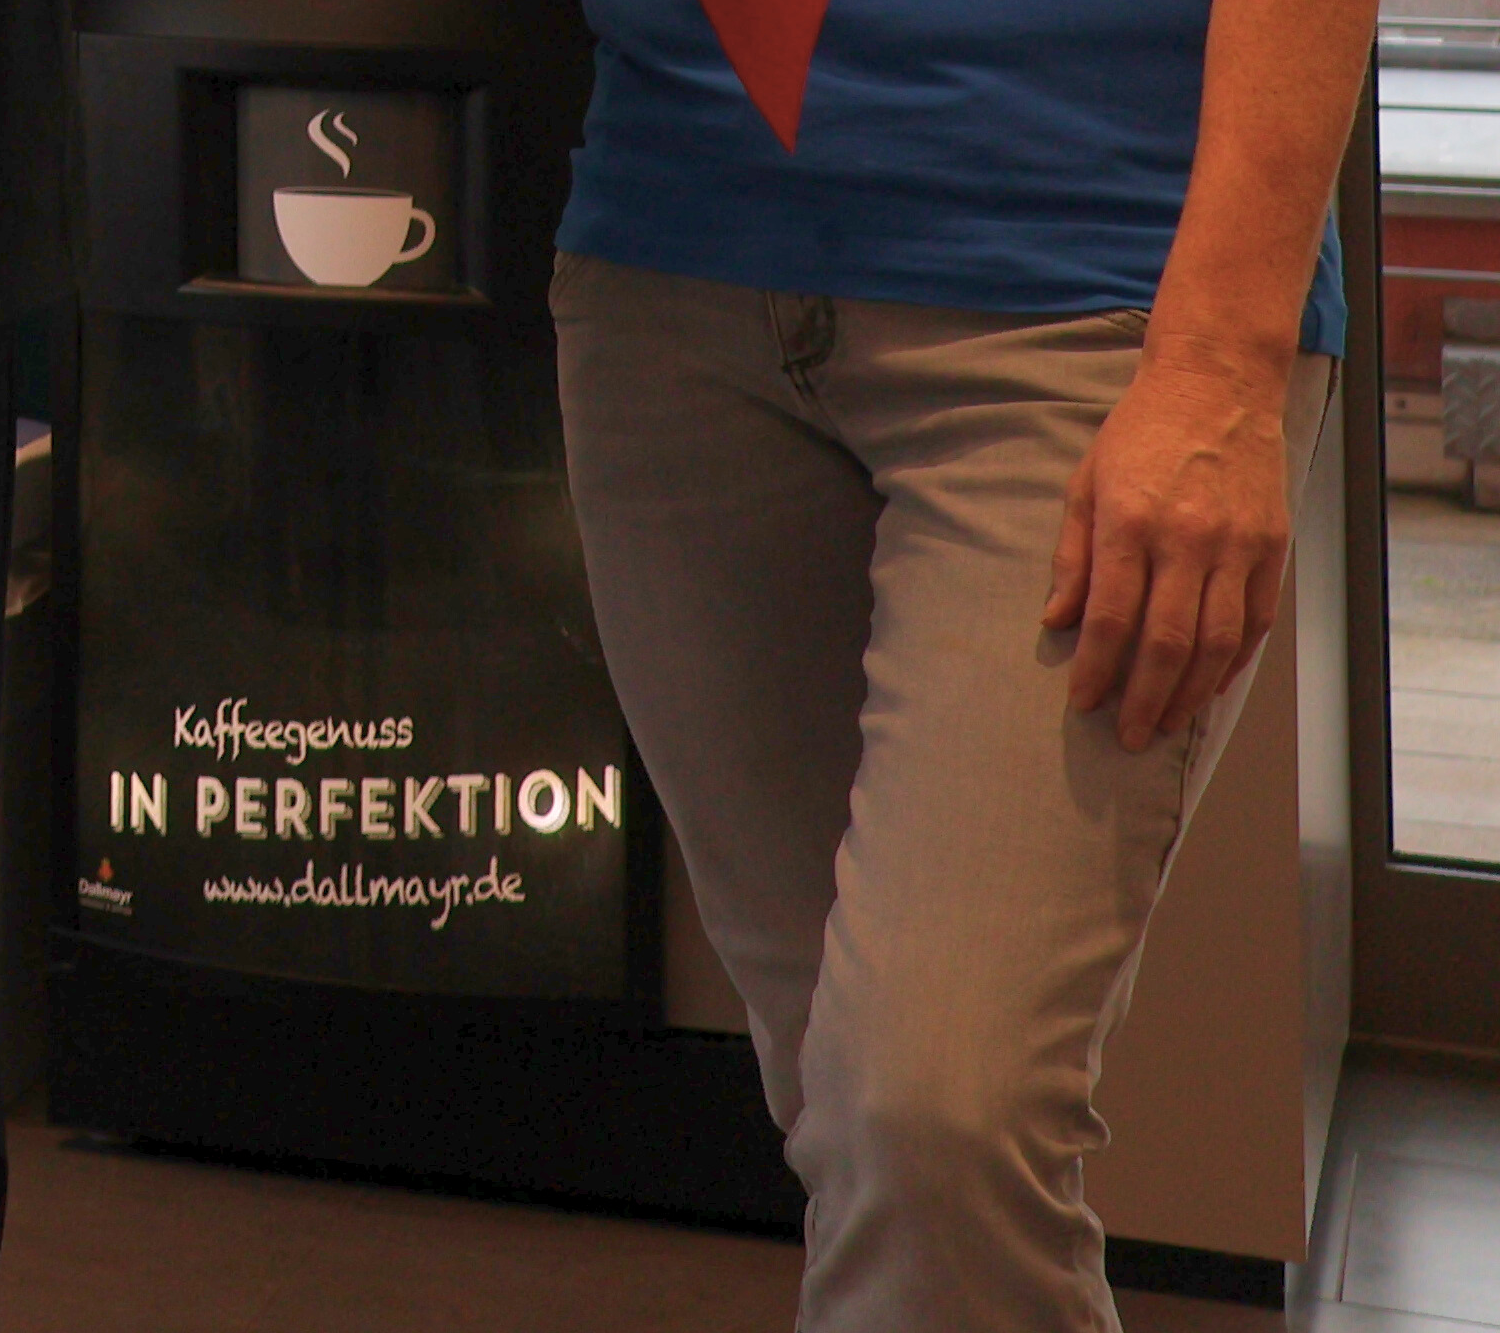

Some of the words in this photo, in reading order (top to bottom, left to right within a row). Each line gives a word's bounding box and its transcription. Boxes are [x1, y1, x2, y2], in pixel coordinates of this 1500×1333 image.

[173, 696, 413, 766] Kaffeegenuss
[109, 770, 168, 837] IN
[195, 763, 623, 842] PERFEKTION
[78, 878, 133, 906] Dallmayr
[203, 855, 527, 932] www.dallmayr.de
